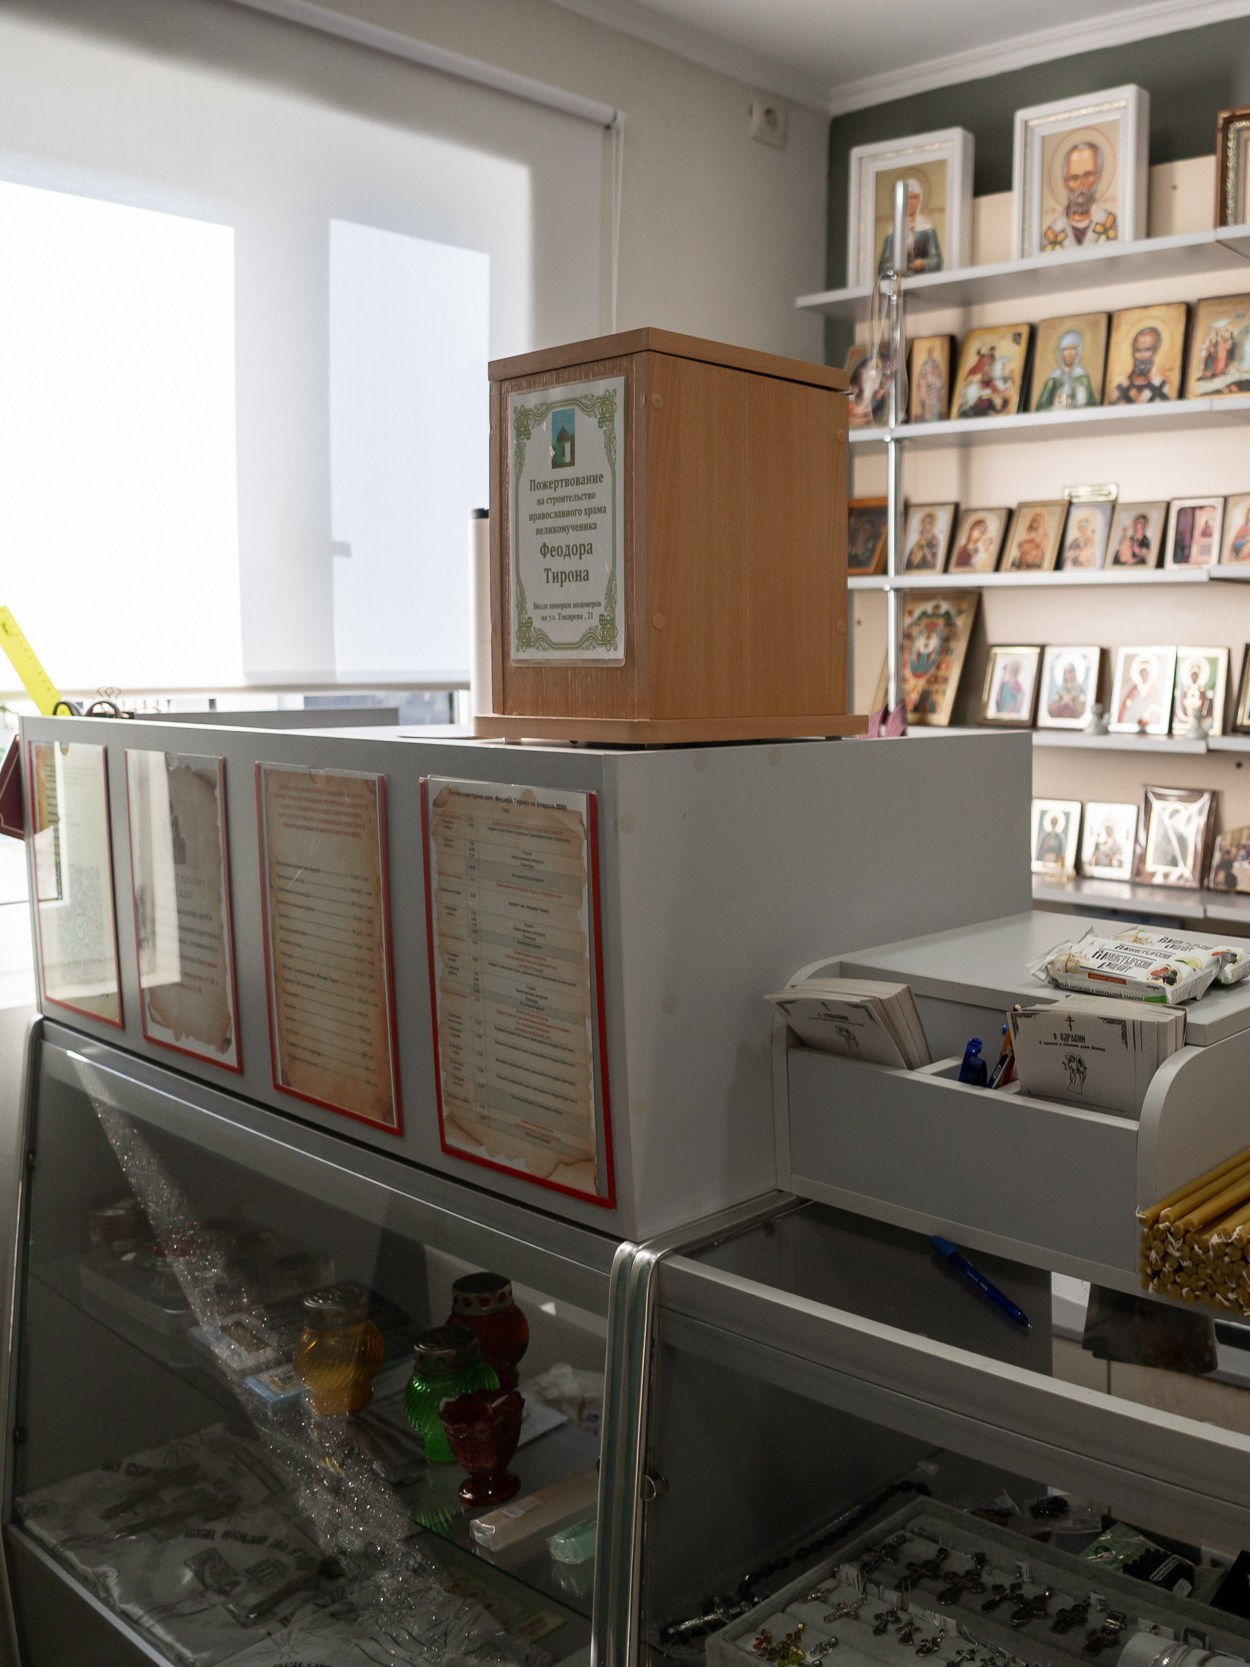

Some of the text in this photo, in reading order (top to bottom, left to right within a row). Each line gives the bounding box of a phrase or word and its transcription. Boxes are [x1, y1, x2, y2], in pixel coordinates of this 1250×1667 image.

[530, 473, 604, 492] Пожертвование
[536, 492, 596, 507] на строительство
[529, 506, 607, 524] православного храма
[536, 522, 598, 536] великомученика
[540, 542, 594, 560] Феодора
[544, 568, 590, 587] Тирона
[533, 602, 548, 610] Возле
[548, 614, 556, 624] ул.
[558, 612, 584, 622] Токарева
[587, 610, 594, 620] 21
